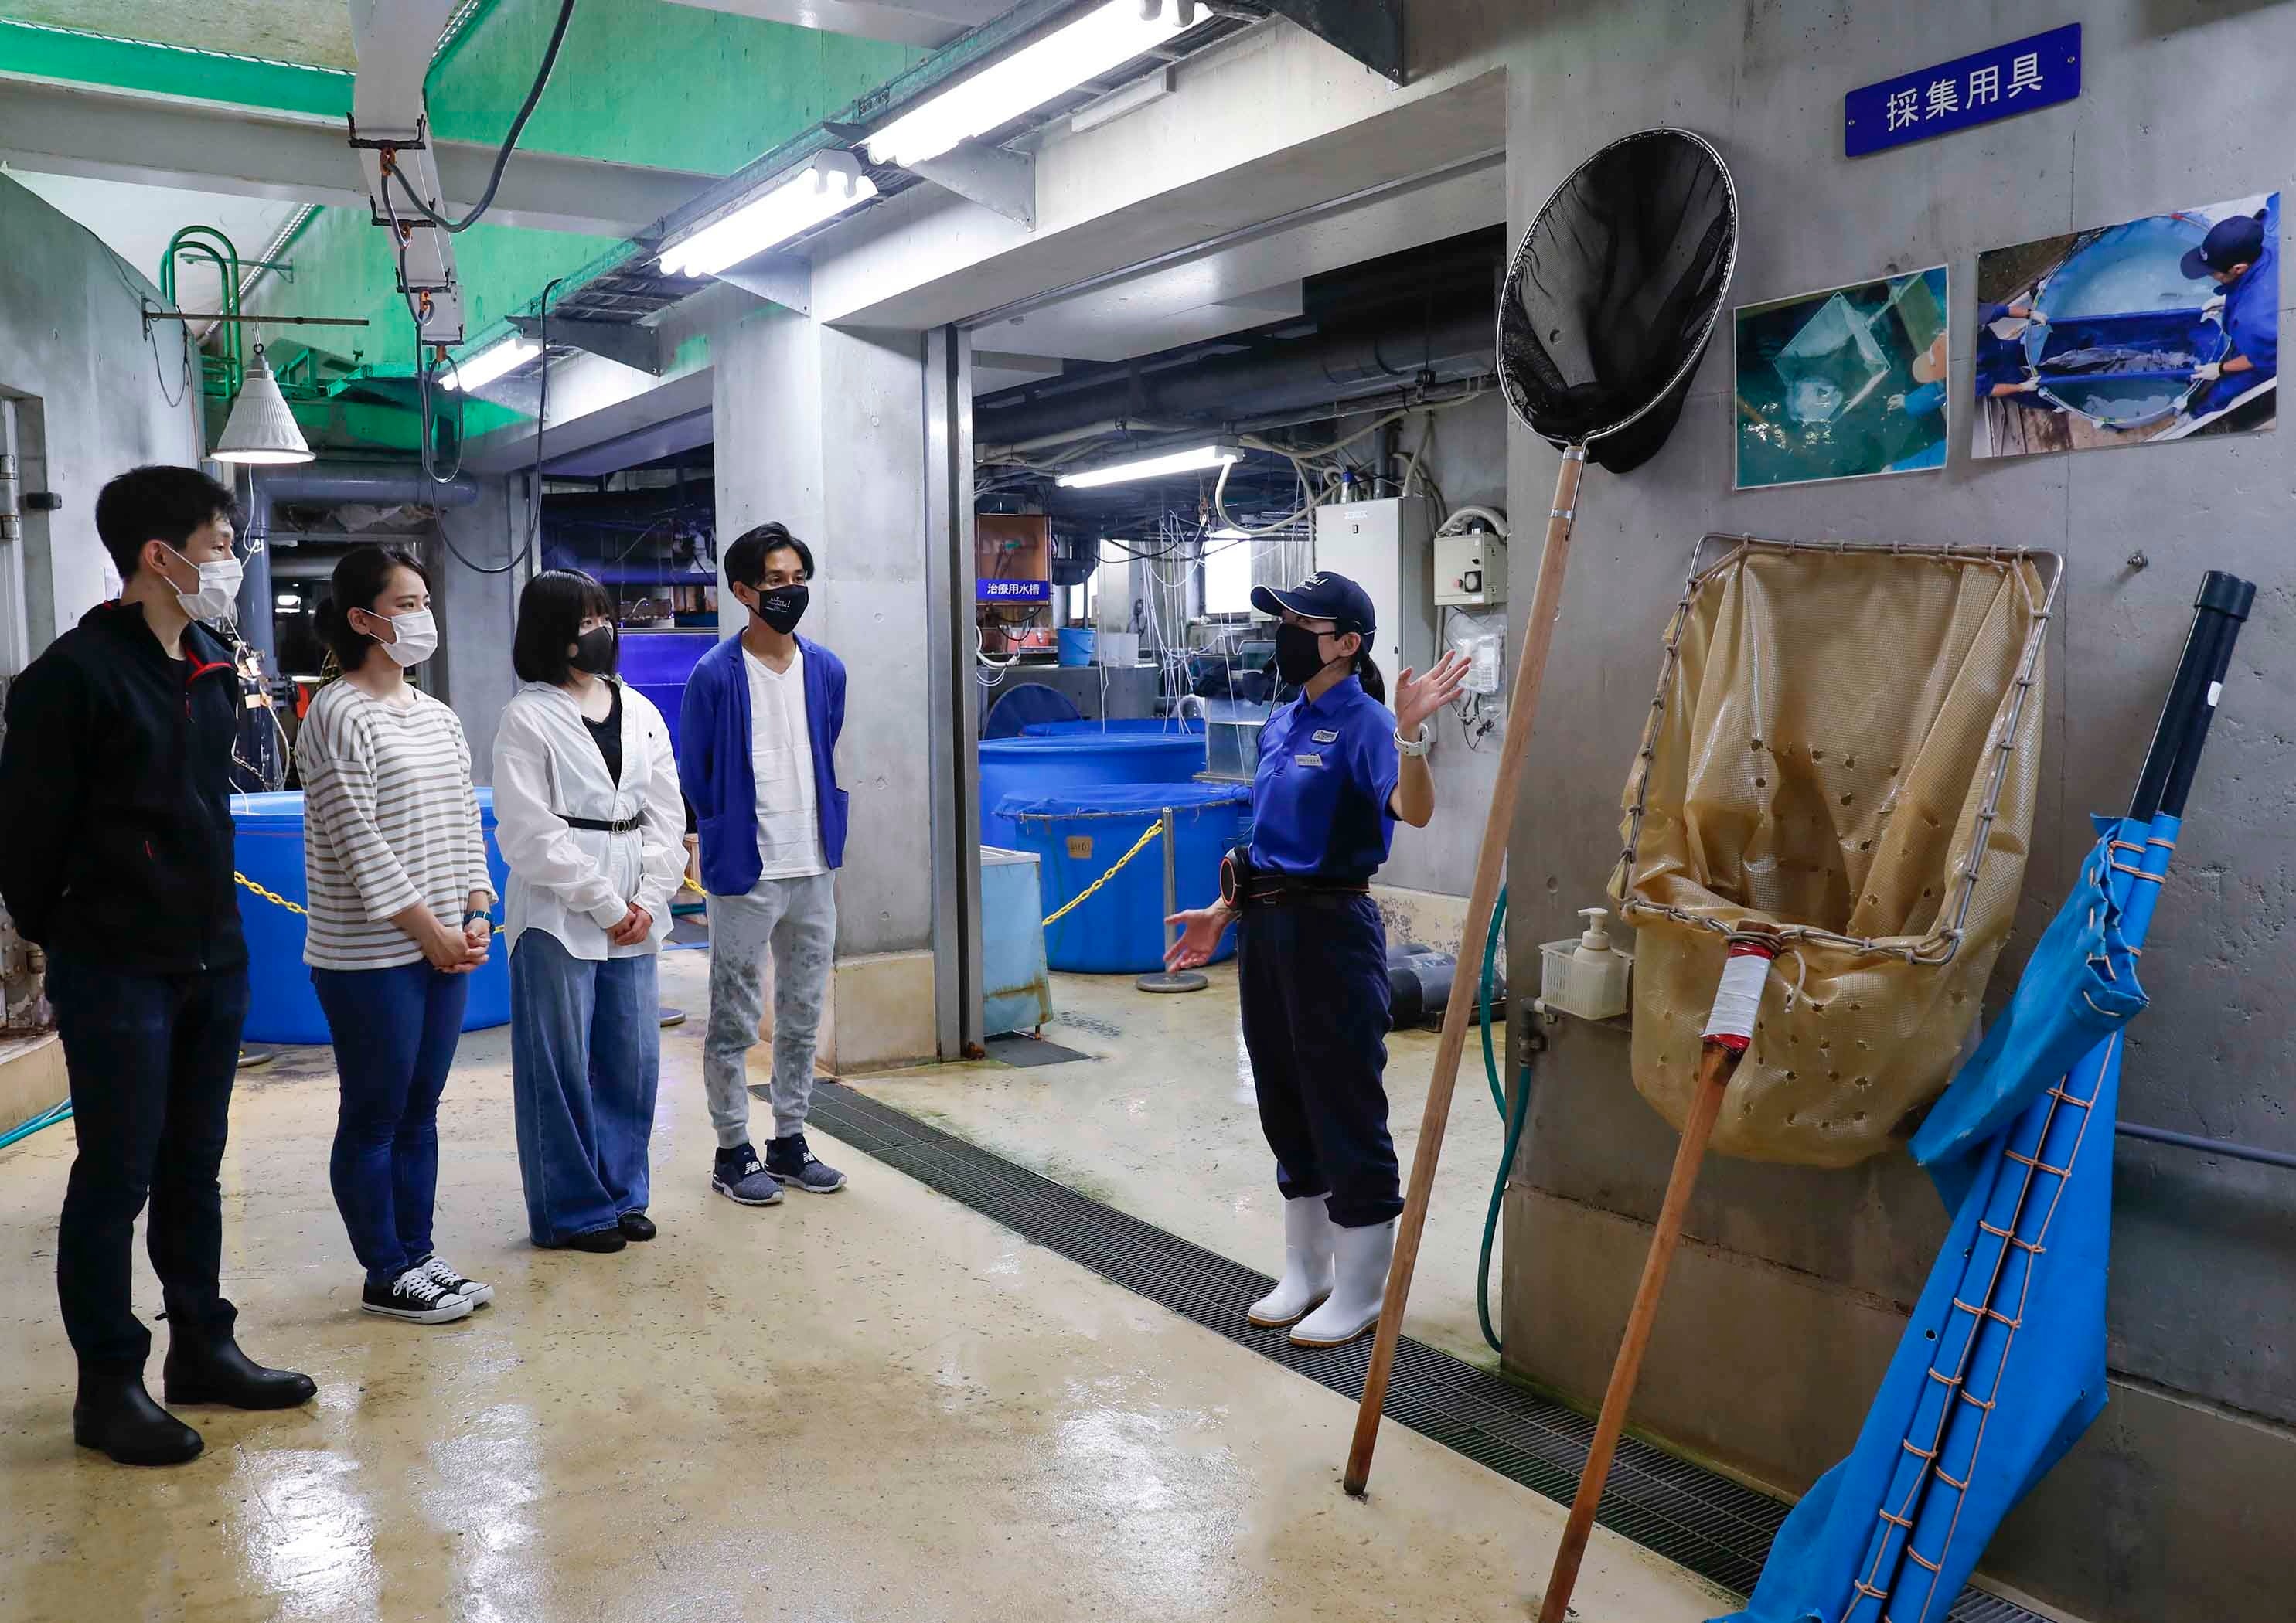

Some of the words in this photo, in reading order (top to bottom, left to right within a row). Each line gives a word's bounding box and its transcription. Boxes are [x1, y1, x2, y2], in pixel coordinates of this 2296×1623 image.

[1886, 53, 2043, 131] 採集用具
[986, 583, 1040, 595] 治療用水槽
